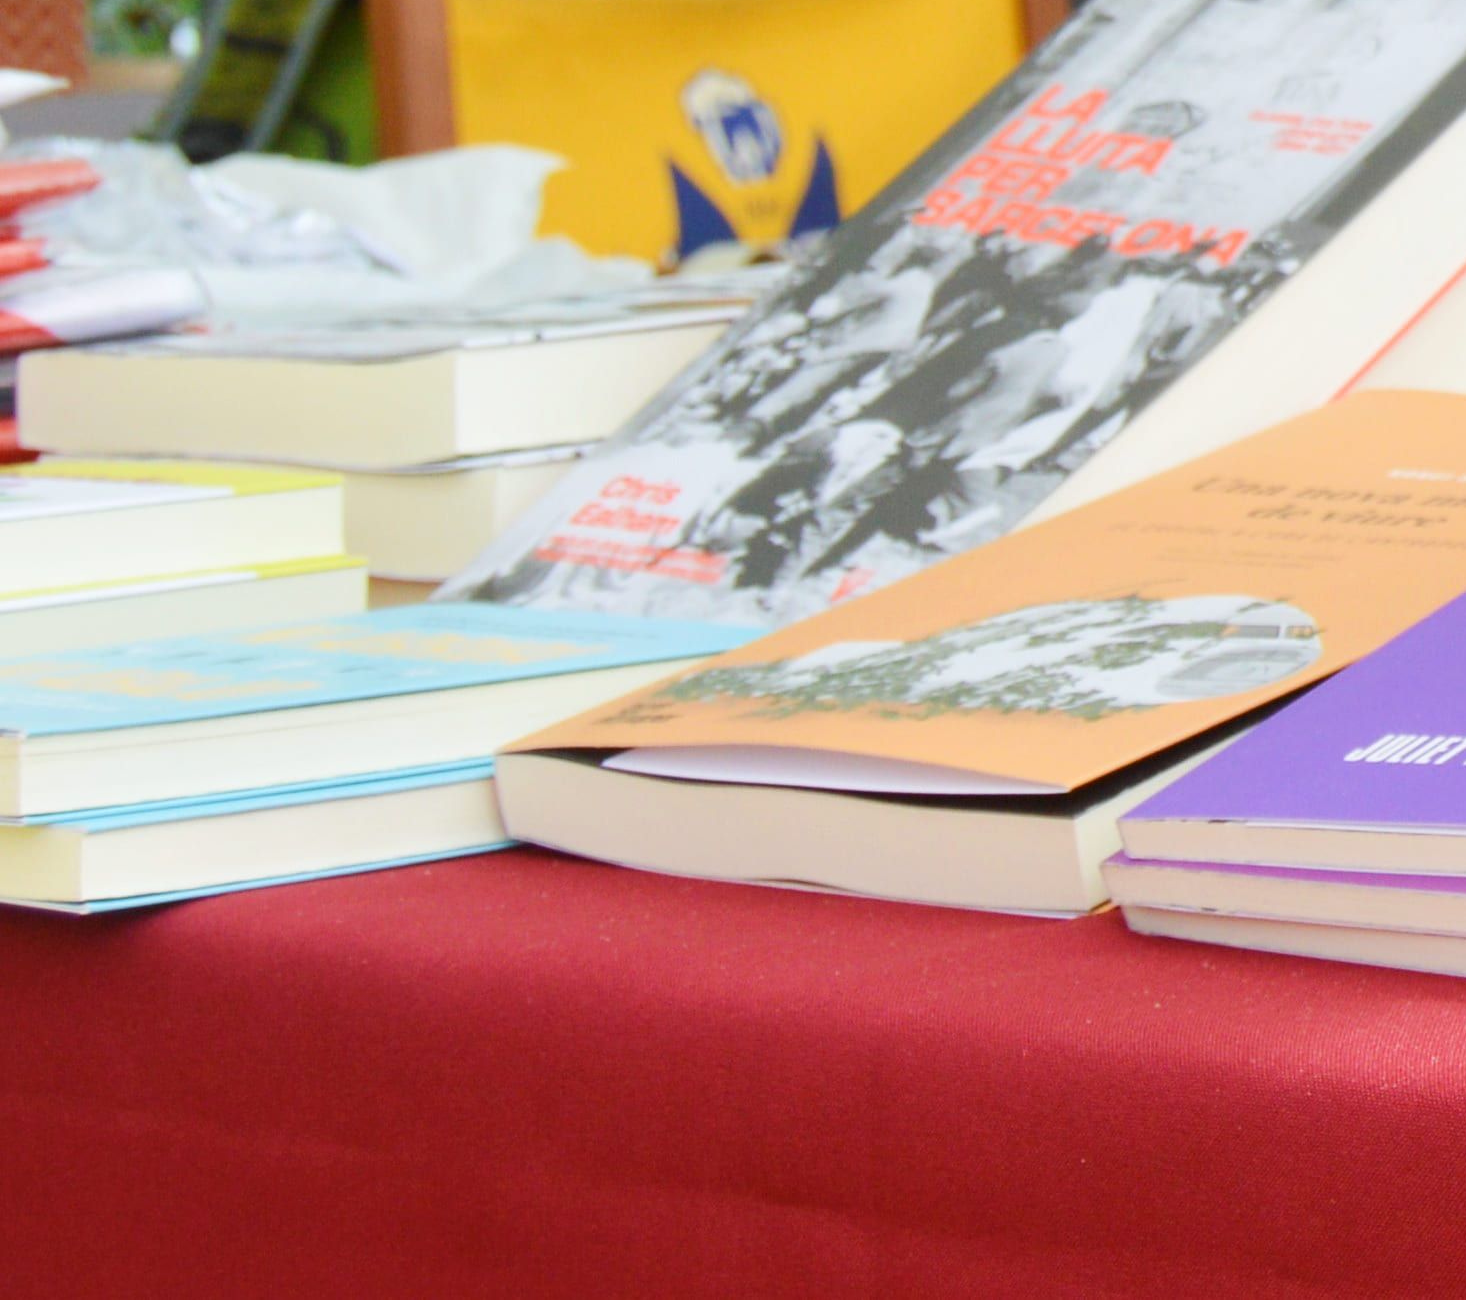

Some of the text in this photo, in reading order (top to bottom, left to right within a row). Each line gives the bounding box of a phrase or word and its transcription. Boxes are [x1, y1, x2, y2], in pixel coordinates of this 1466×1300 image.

[1025, 83, 1111, 127] LA
[983, 117, 1175, 175] LLUITA
[941, 149, 1071, 201] PER
